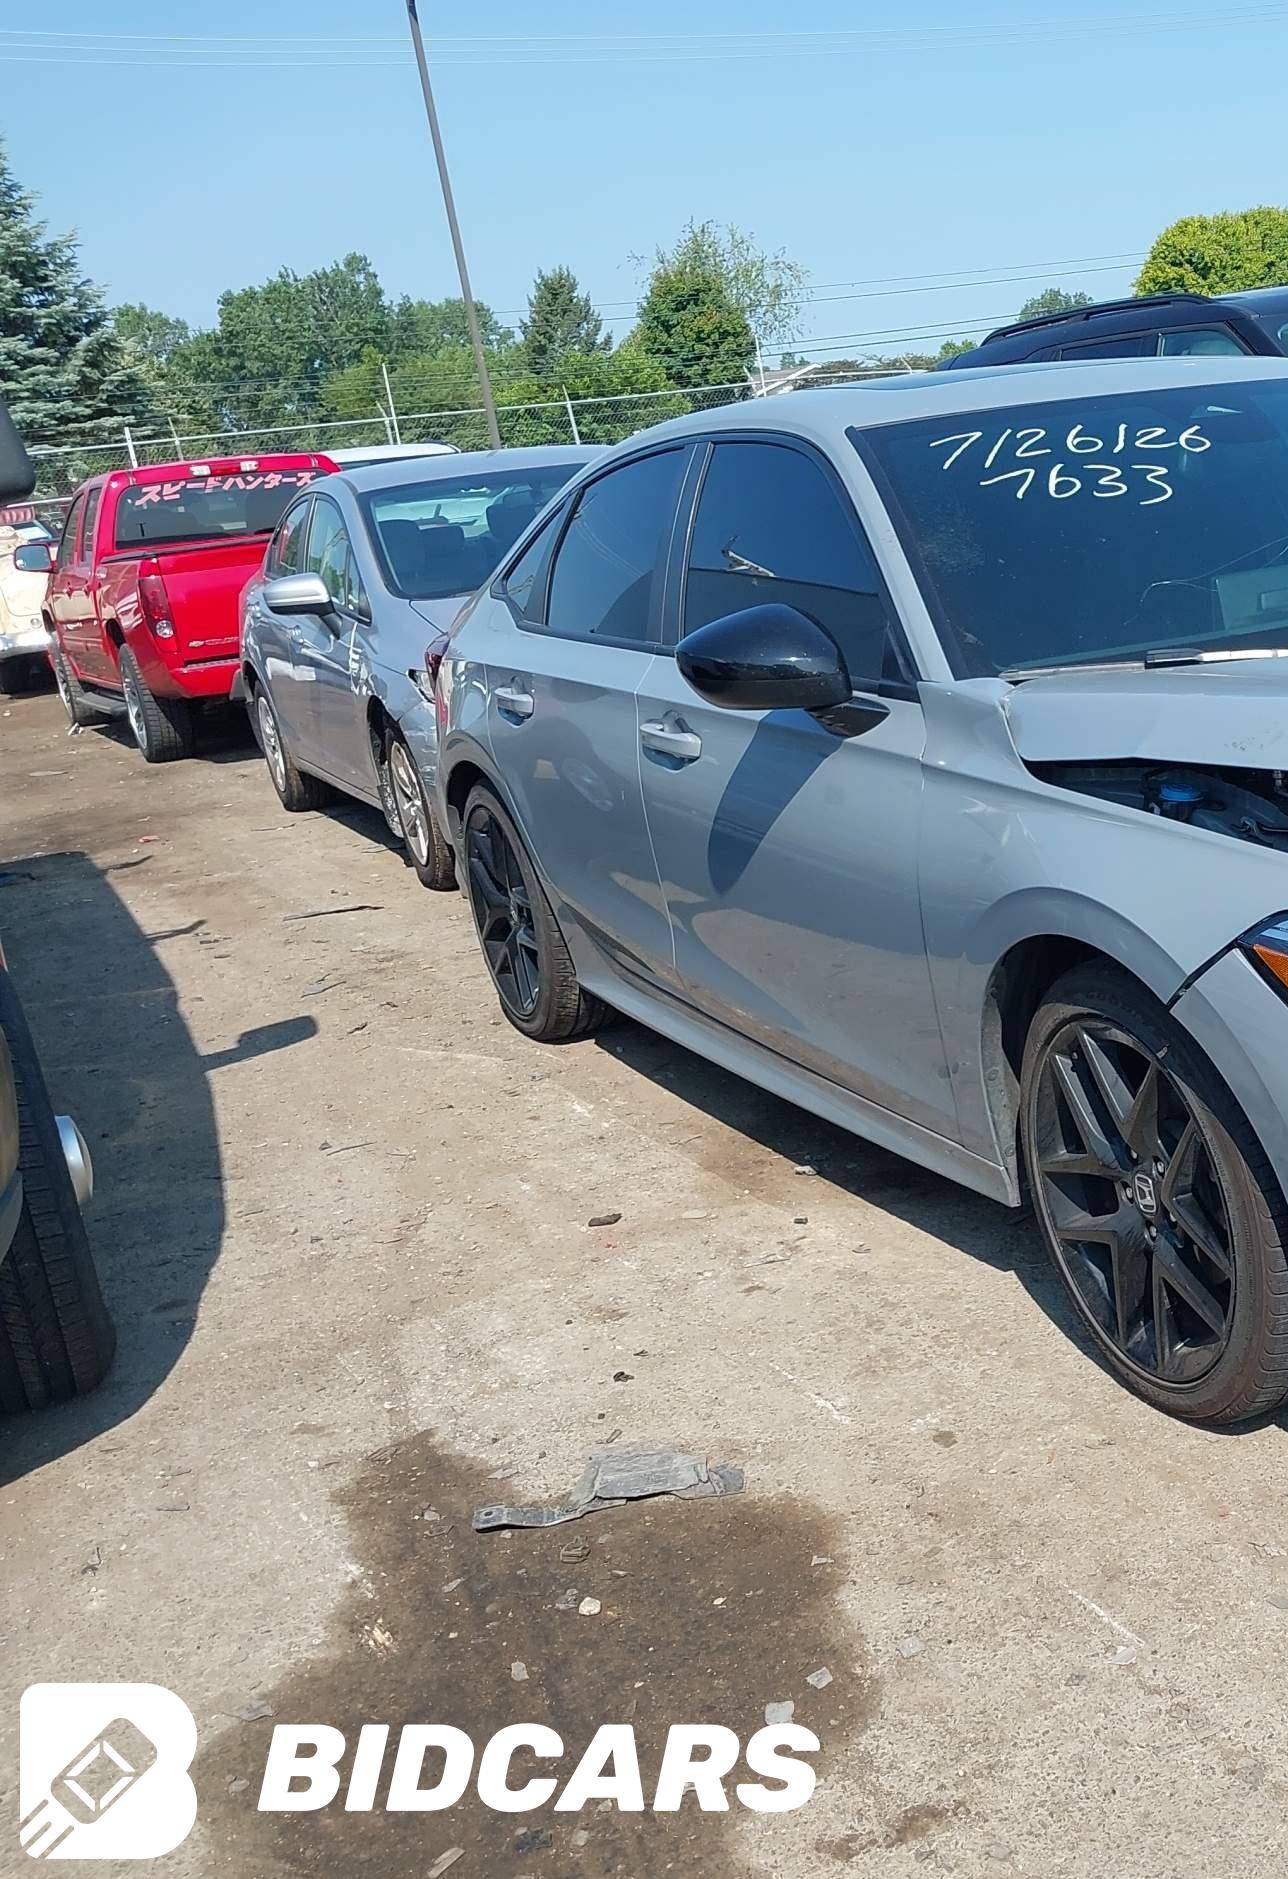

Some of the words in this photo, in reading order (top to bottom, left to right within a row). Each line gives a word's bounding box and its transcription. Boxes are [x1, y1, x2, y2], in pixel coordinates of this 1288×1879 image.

[134, 471, 317, 507] スピードハンターズ
[979, 463, 1173, 505] 7633
